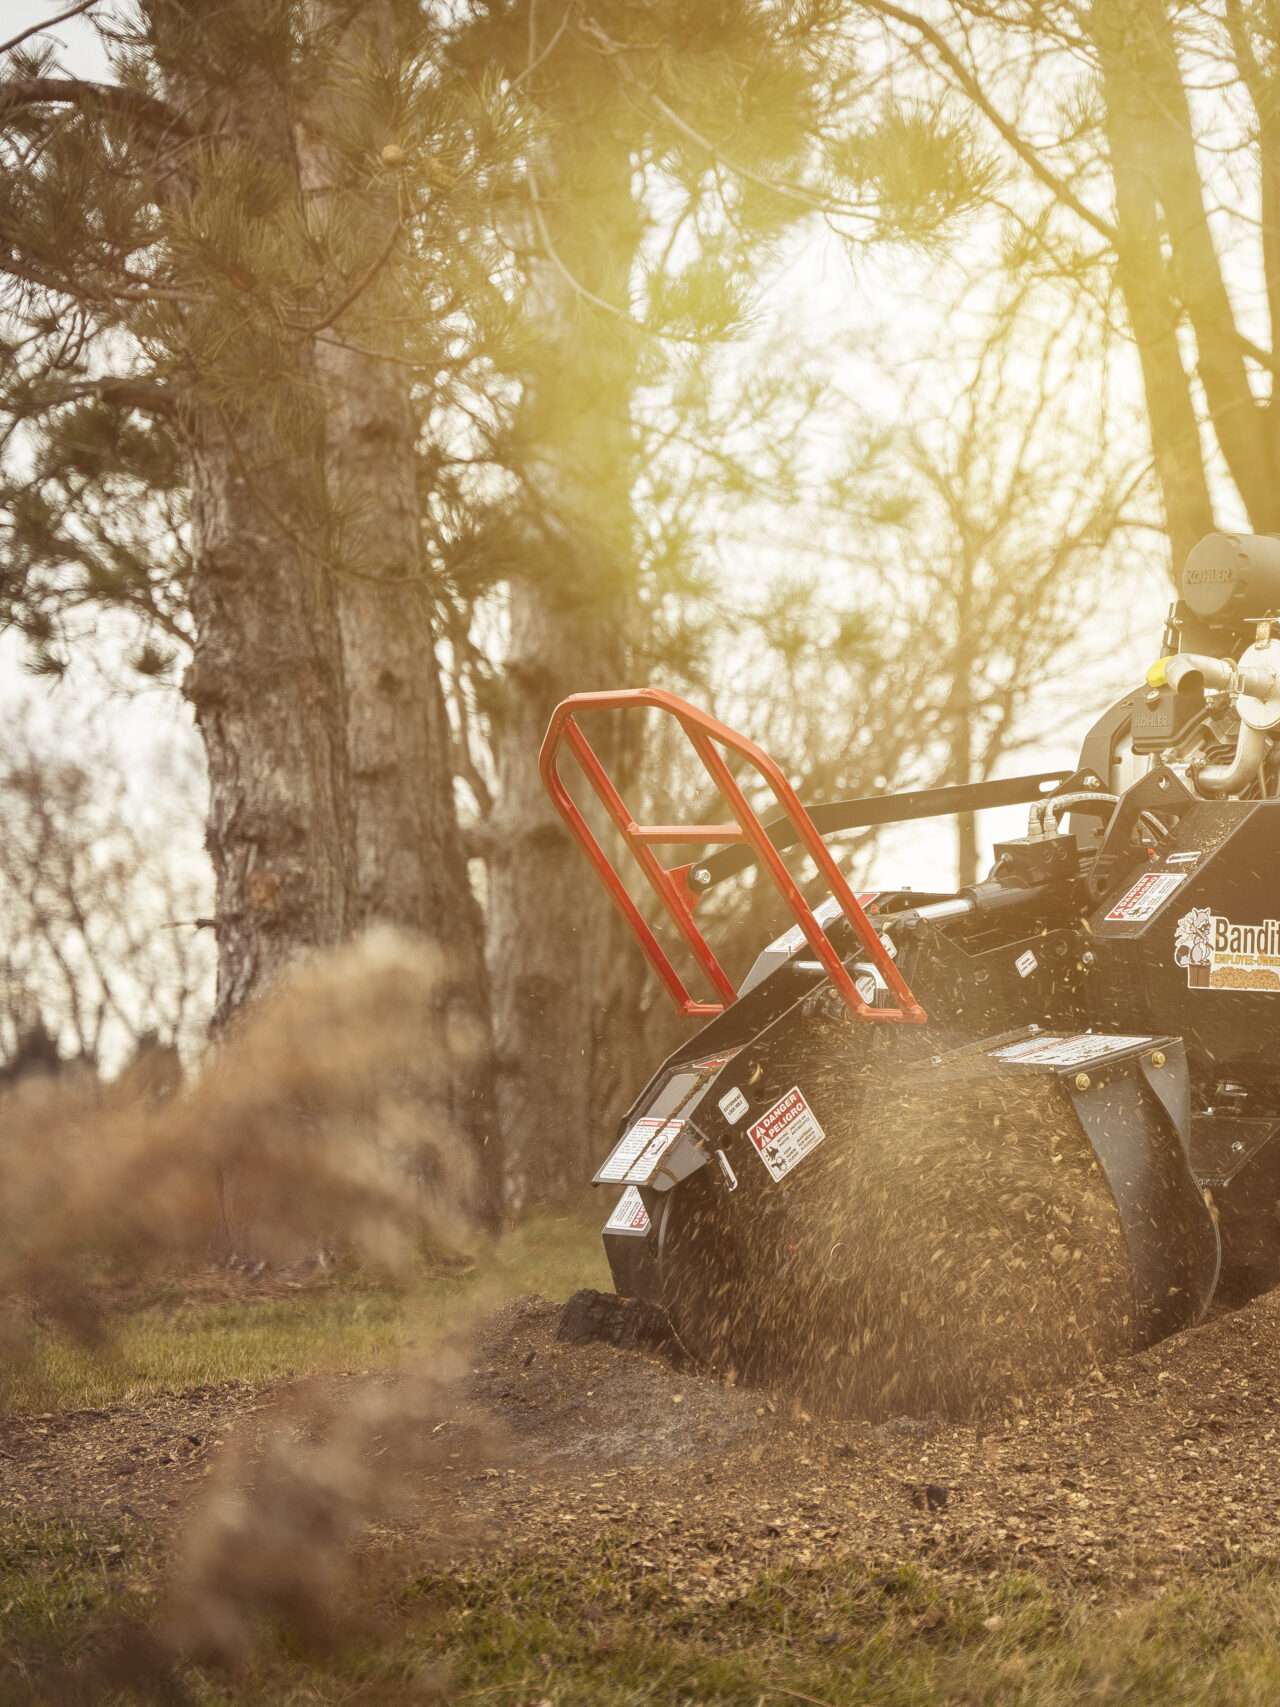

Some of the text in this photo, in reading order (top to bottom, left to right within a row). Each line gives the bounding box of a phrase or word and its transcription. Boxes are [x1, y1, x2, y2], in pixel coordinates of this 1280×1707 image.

[1184, 567, 1233, 584] KOHLER
[763, 1094, 797, 1128] DANGER
[768, 1103, 804, 1138] PELIGRO
